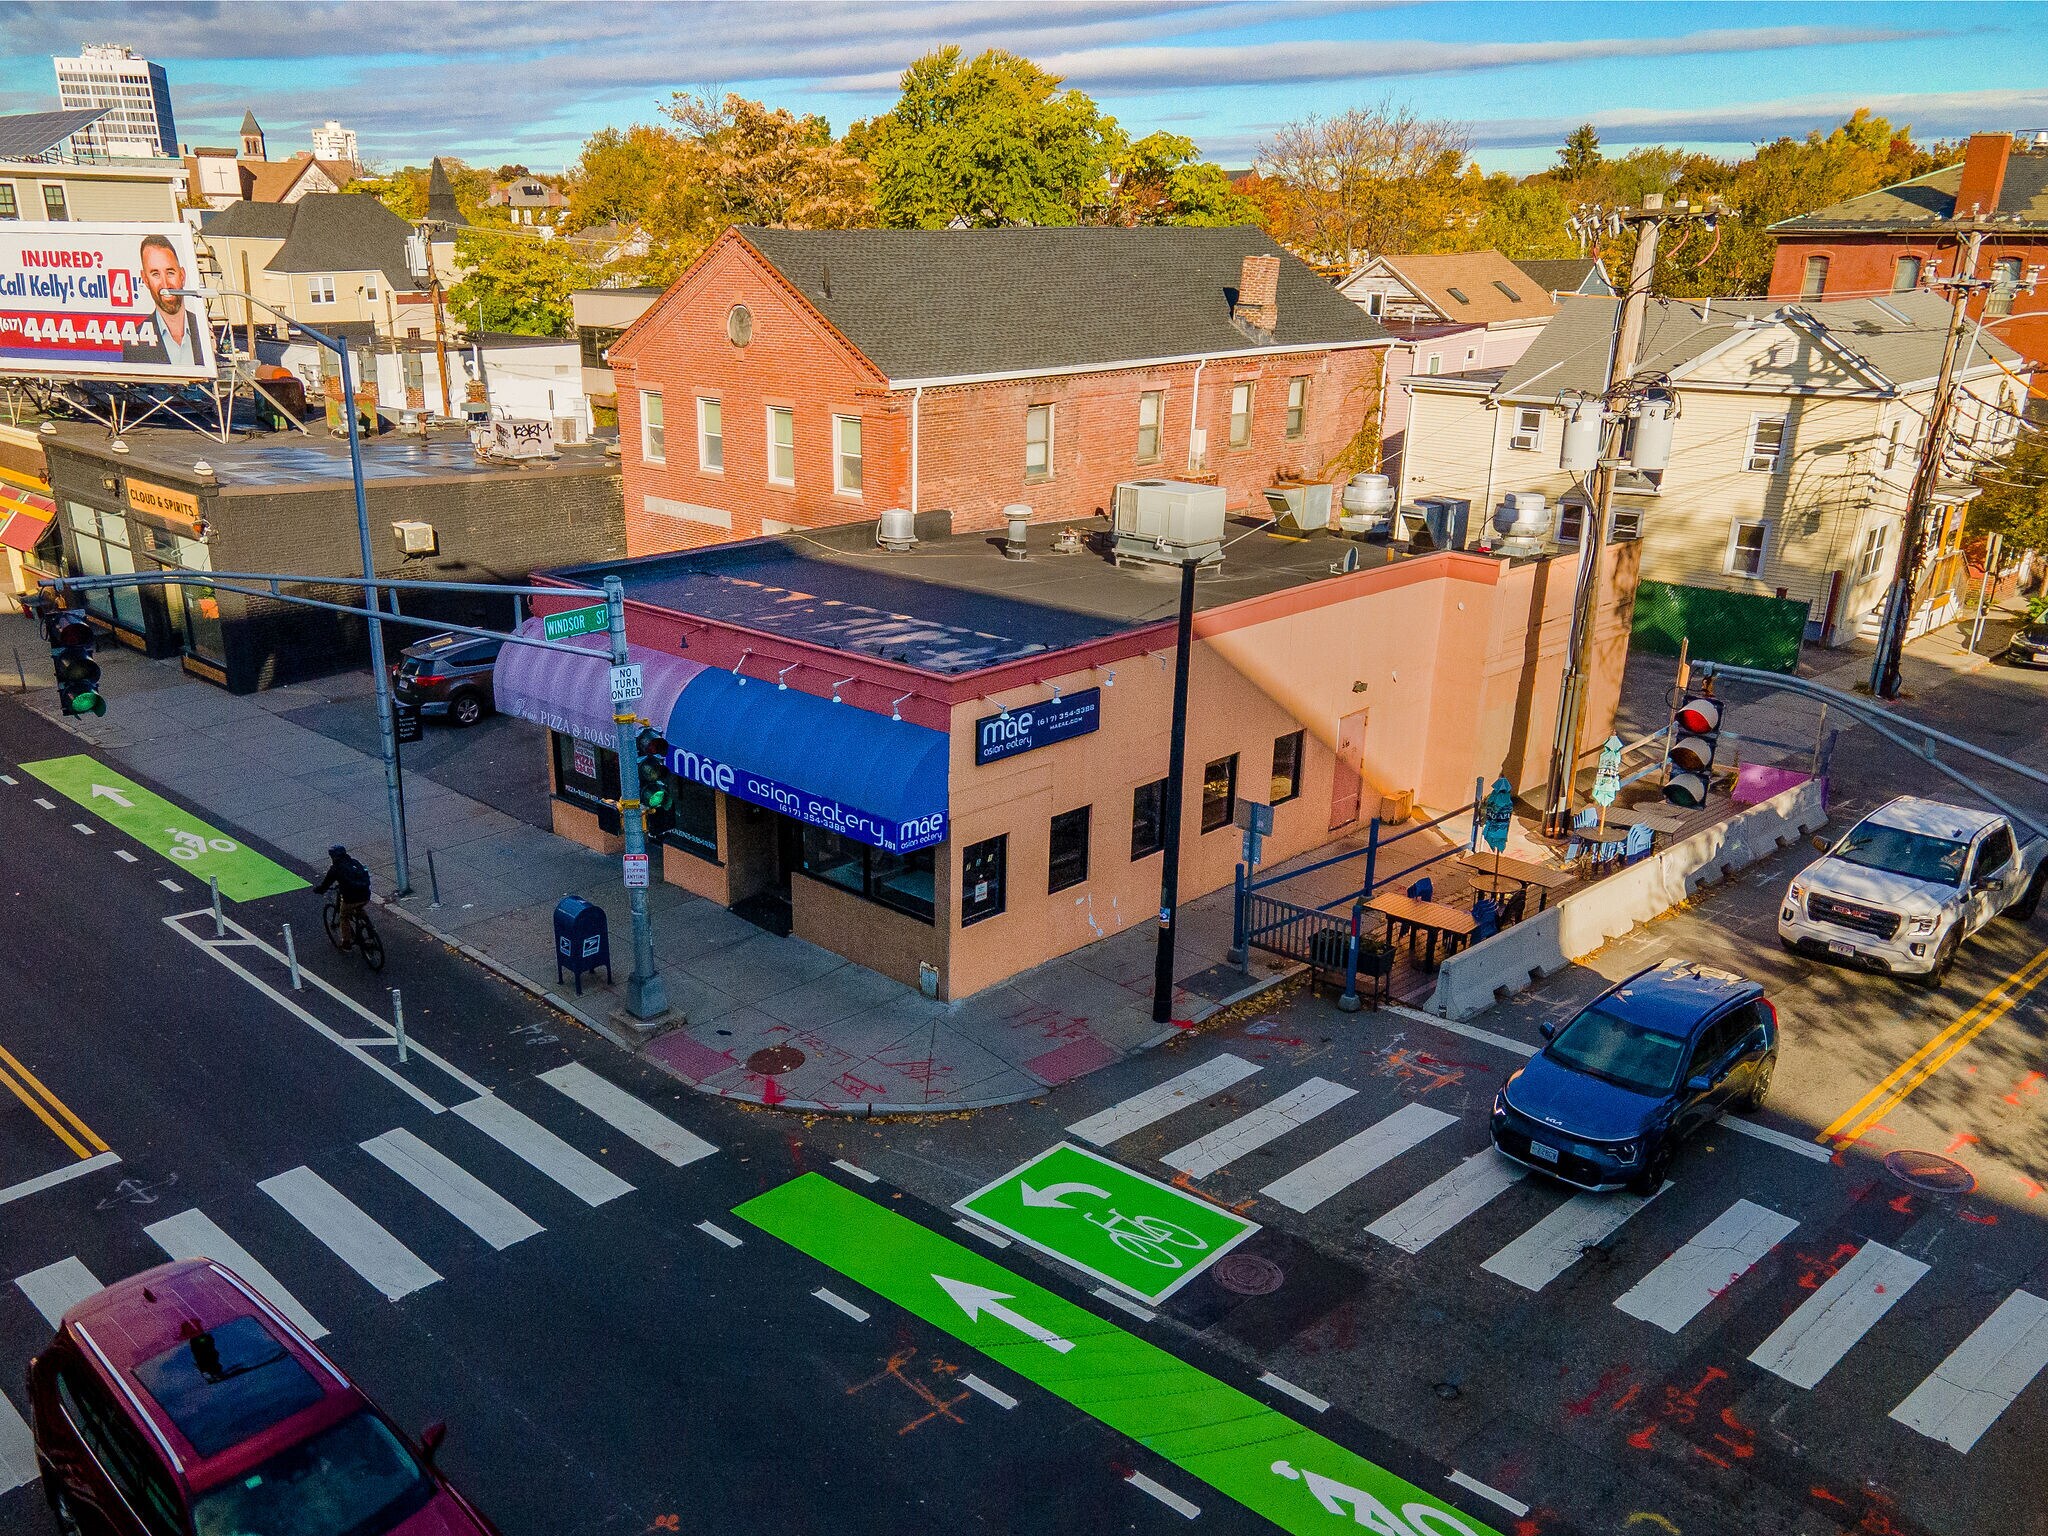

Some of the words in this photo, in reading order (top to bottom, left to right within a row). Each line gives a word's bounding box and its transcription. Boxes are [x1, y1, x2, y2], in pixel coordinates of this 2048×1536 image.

[21, 250, 104, 268] INJURED?
[0, 272, 26, 296] Call
[29, 273, 74, 304] Kelly!
[78, 274, 108, 299] Call
[0, 317, 23, 334] (617)
[24, 317, 158, 347] 444-4444
[130, 489, 155, 506] CLOUD
[157, 496, 163, 508] &
[164, 498, 194, 517] SPIRITS
[546, 615, 585, 635] WINDSOR
[596, 610, 606, 625] ST
[614, 677, 638, 689] TURN
[619, 668, 632, 678] NO
[611, 690, 623, 700] ON
[625, 687, 642, 698] RED
[540, 710, 570, 734] PIZZA
[584, 727, 616, 749] ROAST
[983, 712, 1033, 746] mâe
[1037, 714, 1057, 728] (617)
[983, 743, 1004, 757] asian
[1005, 735, 1033, 749] eatery
[673, 748, 735, 792] mâe
[747, 779, 800, 809] asian
[808, 801, 884, 847] eatery
[779, 803, 801, 818] (617)
[900, 812, 943, 841] mâe
[884, 839, 896, 850] 781
[900, 839, 918, 850] asian
[919, 831, 943, 847] eatery
[1831, 904, 1871, 921] GMC
